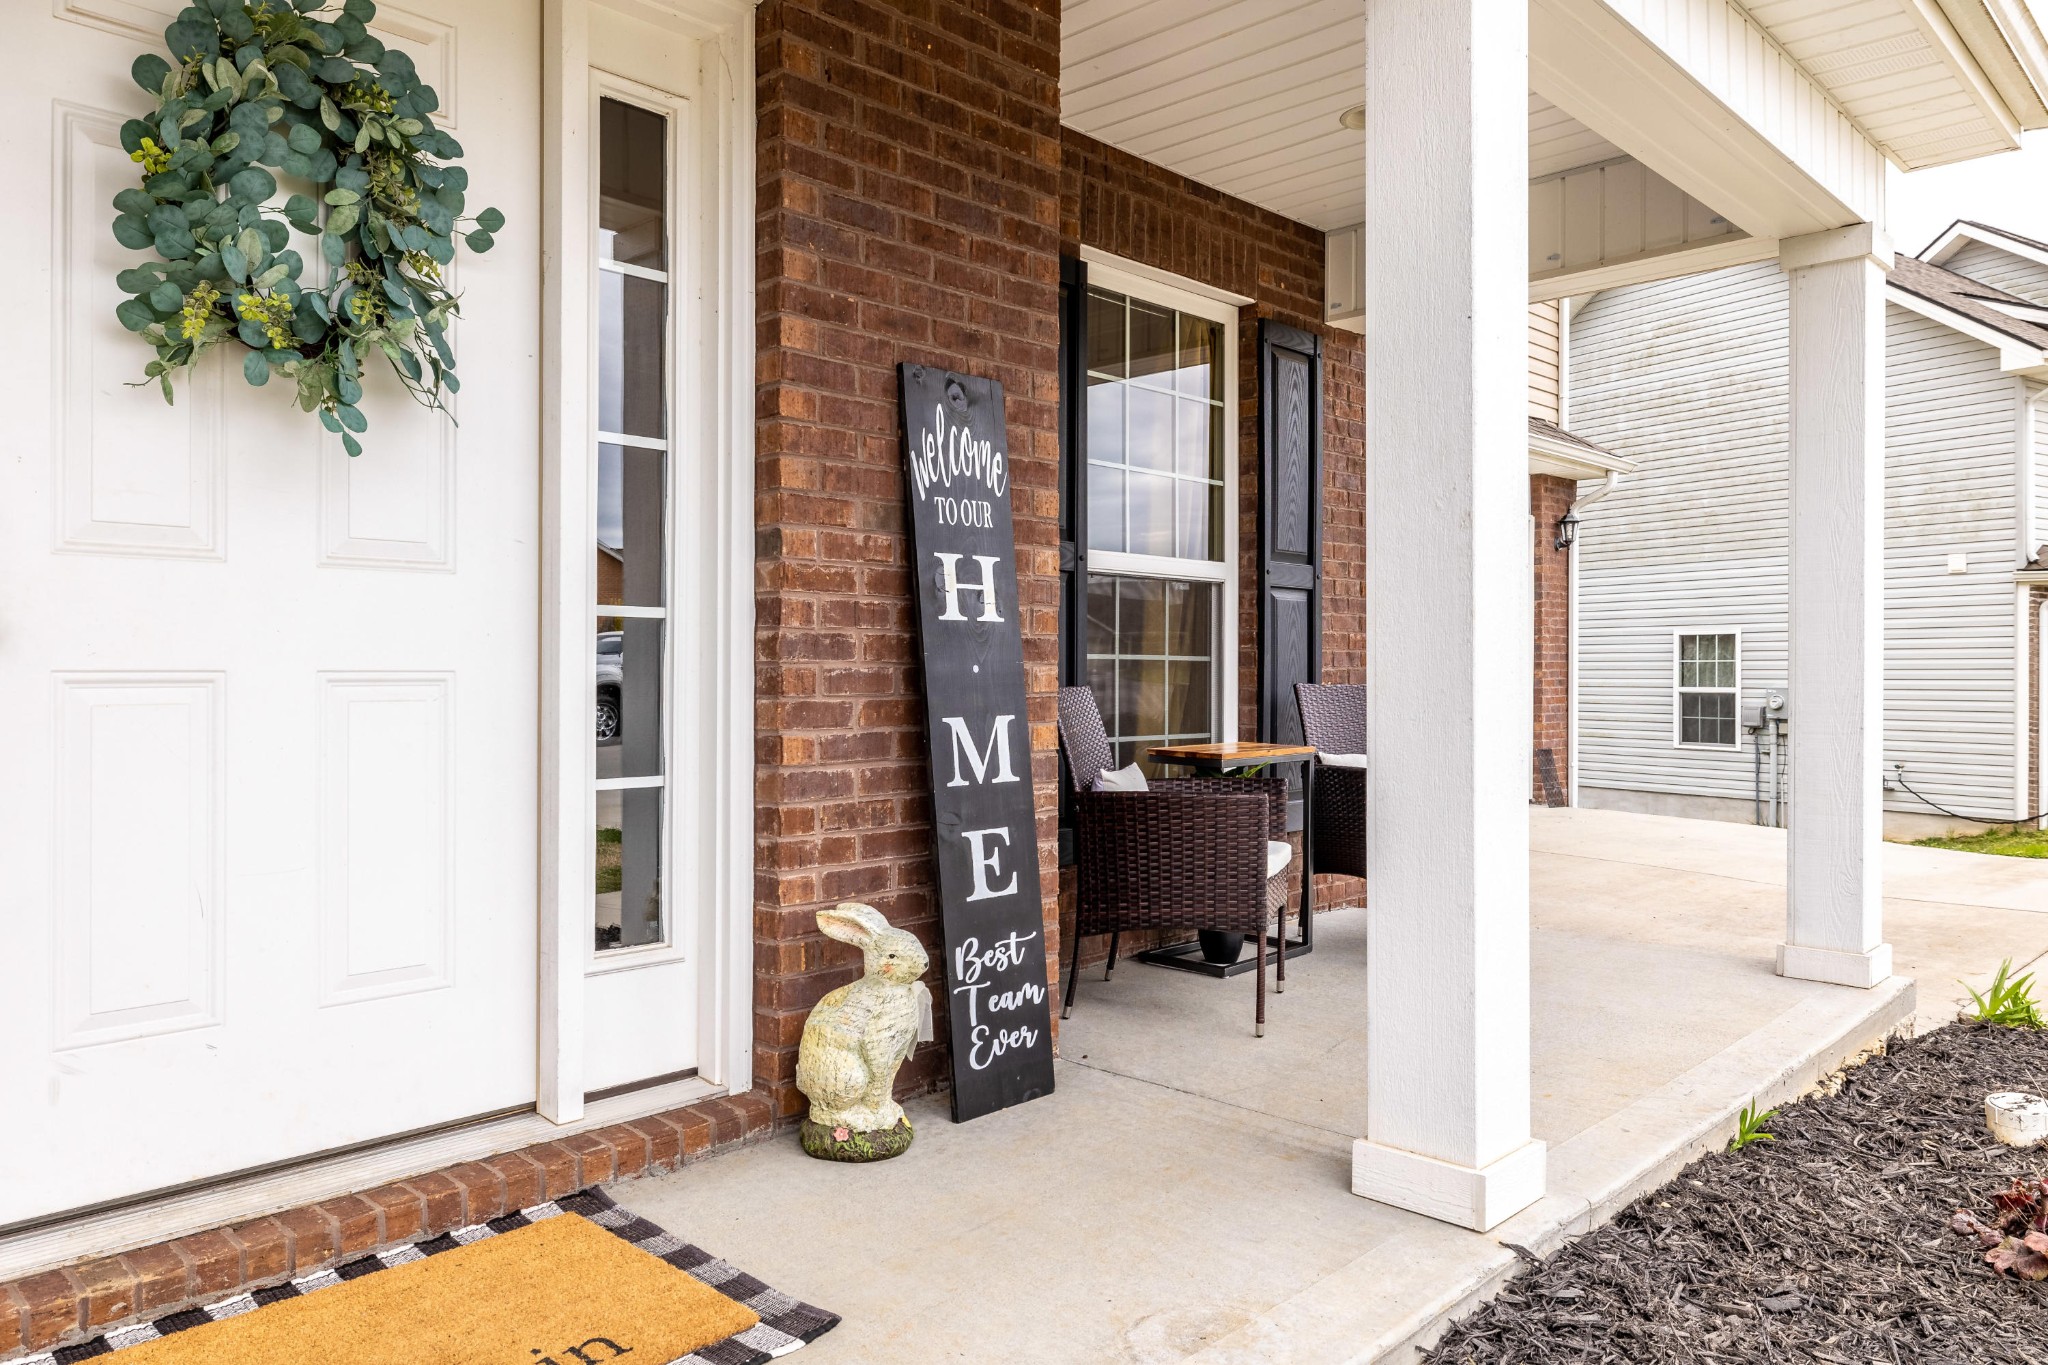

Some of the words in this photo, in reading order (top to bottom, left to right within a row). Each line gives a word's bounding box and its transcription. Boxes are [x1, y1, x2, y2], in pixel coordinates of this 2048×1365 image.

[934, 496, 958, 525] TO
[960, 498, 994, 529] OUR
[955, 931, 1037, 984] Best
[953, 981, 1046, 1027] Team
[969, 1025, 1039, 1071] Ever
